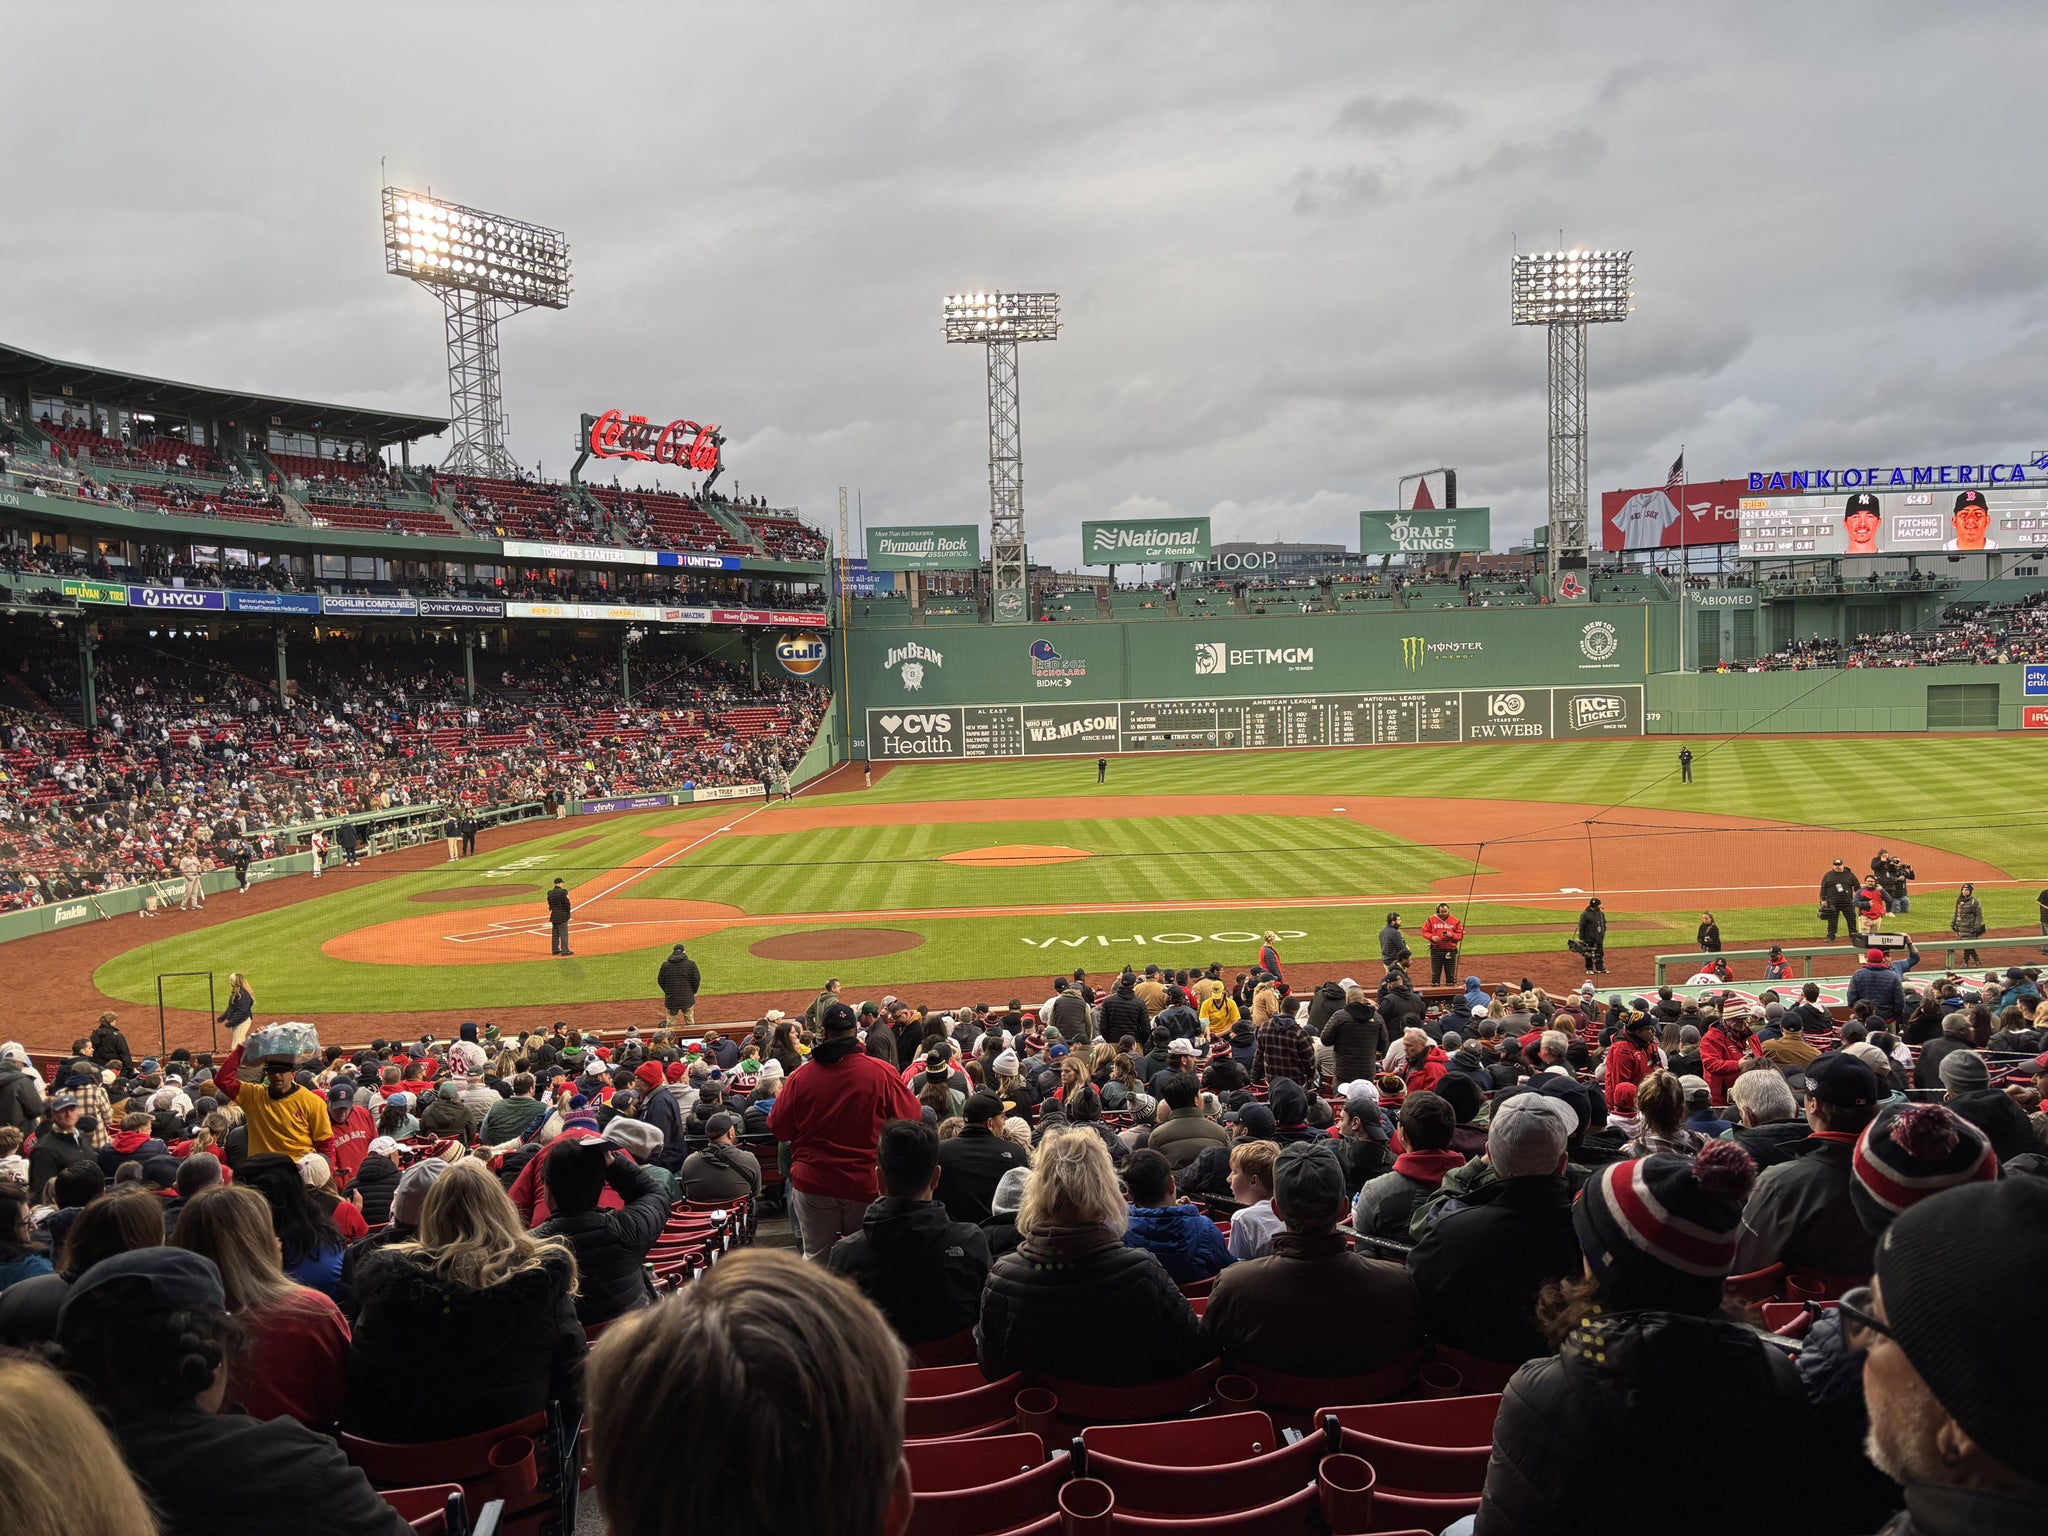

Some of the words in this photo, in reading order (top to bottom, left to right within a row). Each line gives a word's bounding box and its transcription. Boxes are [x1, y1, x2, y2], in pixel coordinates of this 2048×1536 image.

[1748, 470, 1835, 490] BANK
[1843, 468, 1879, 487] OF
[1889, 464, 2027, 486] AMERICA
[1741, 500, 1767, 509] FRIED
[1907, 494, 1928, 504] 6:43
[1645, 510, 1659, 519] SOX
[1899, 518, 1937, 527] PITCHING
[2021, 520, 2035, 528] 22.1
[1391, 526, 1456, 541] DRAFT
[1760, 528, 1775, 536] 33.1
[1898, 528, 1938, 537] MATCHUP
[880, 539, 934, 553] Plymouth
[938, 537, 967, 550] Rock
[1400, 538, 1454, 550] KINGS
[1755, 542, 1774, 551] 2.97
[542, 546, 584, 559] TONIGHT'S
[585, 549, 624, 560] STARTERS
[1165, 547, 1194, 555] Rental
[688, 556, 723, 567] UNITED
[65, 585, 99, 600] SULLIVAN
[109, 591, 124, 601] TIRE
[162, 593, 204, 605] HYCU
[325, 599, 365, 607] COGHLIN
[366, 600, 415, 609] COMPANIES
[1701, 595, 1753, 605] ABIOMED
[1582, 621, 1602, 634] IBEW
[1603, 622, 1616, 633] 103
[778, 644, 823, 659] Gulf
[1427, 641, 1483, 652] MONSTER
[884, 647, 908, 669] JIM
[907, 642, 943, 668] BEAM
[1230, 647, 1314, 665] BETMGM
[1037, 660, 1058, 669] RED
[1063, 660, 1086, 668] SOX
[1037, 668, 1086, 677] SCHOLARS
[2028, 672, 2046, 681] city
[1037, 679, 1062, 687] BIDMC
[1488, 694, 1525, 716] 160
[1581, 697, 1620, 713] ACE
[1581, 709, 1620, 723] TICKET
[1646, 713, 1661, 721] 379
[903, 714, 952, 733] CVS
[1025, 720, 1040, 728] WHO
[1471, 725, 1496, 738] F.W.
[1501, 723, 1543, 736] WEBB
[883, 735, 952, 754] Health
[593, 801, 615, 813] xfinity
[55, 904, 87, 924] Franklin
